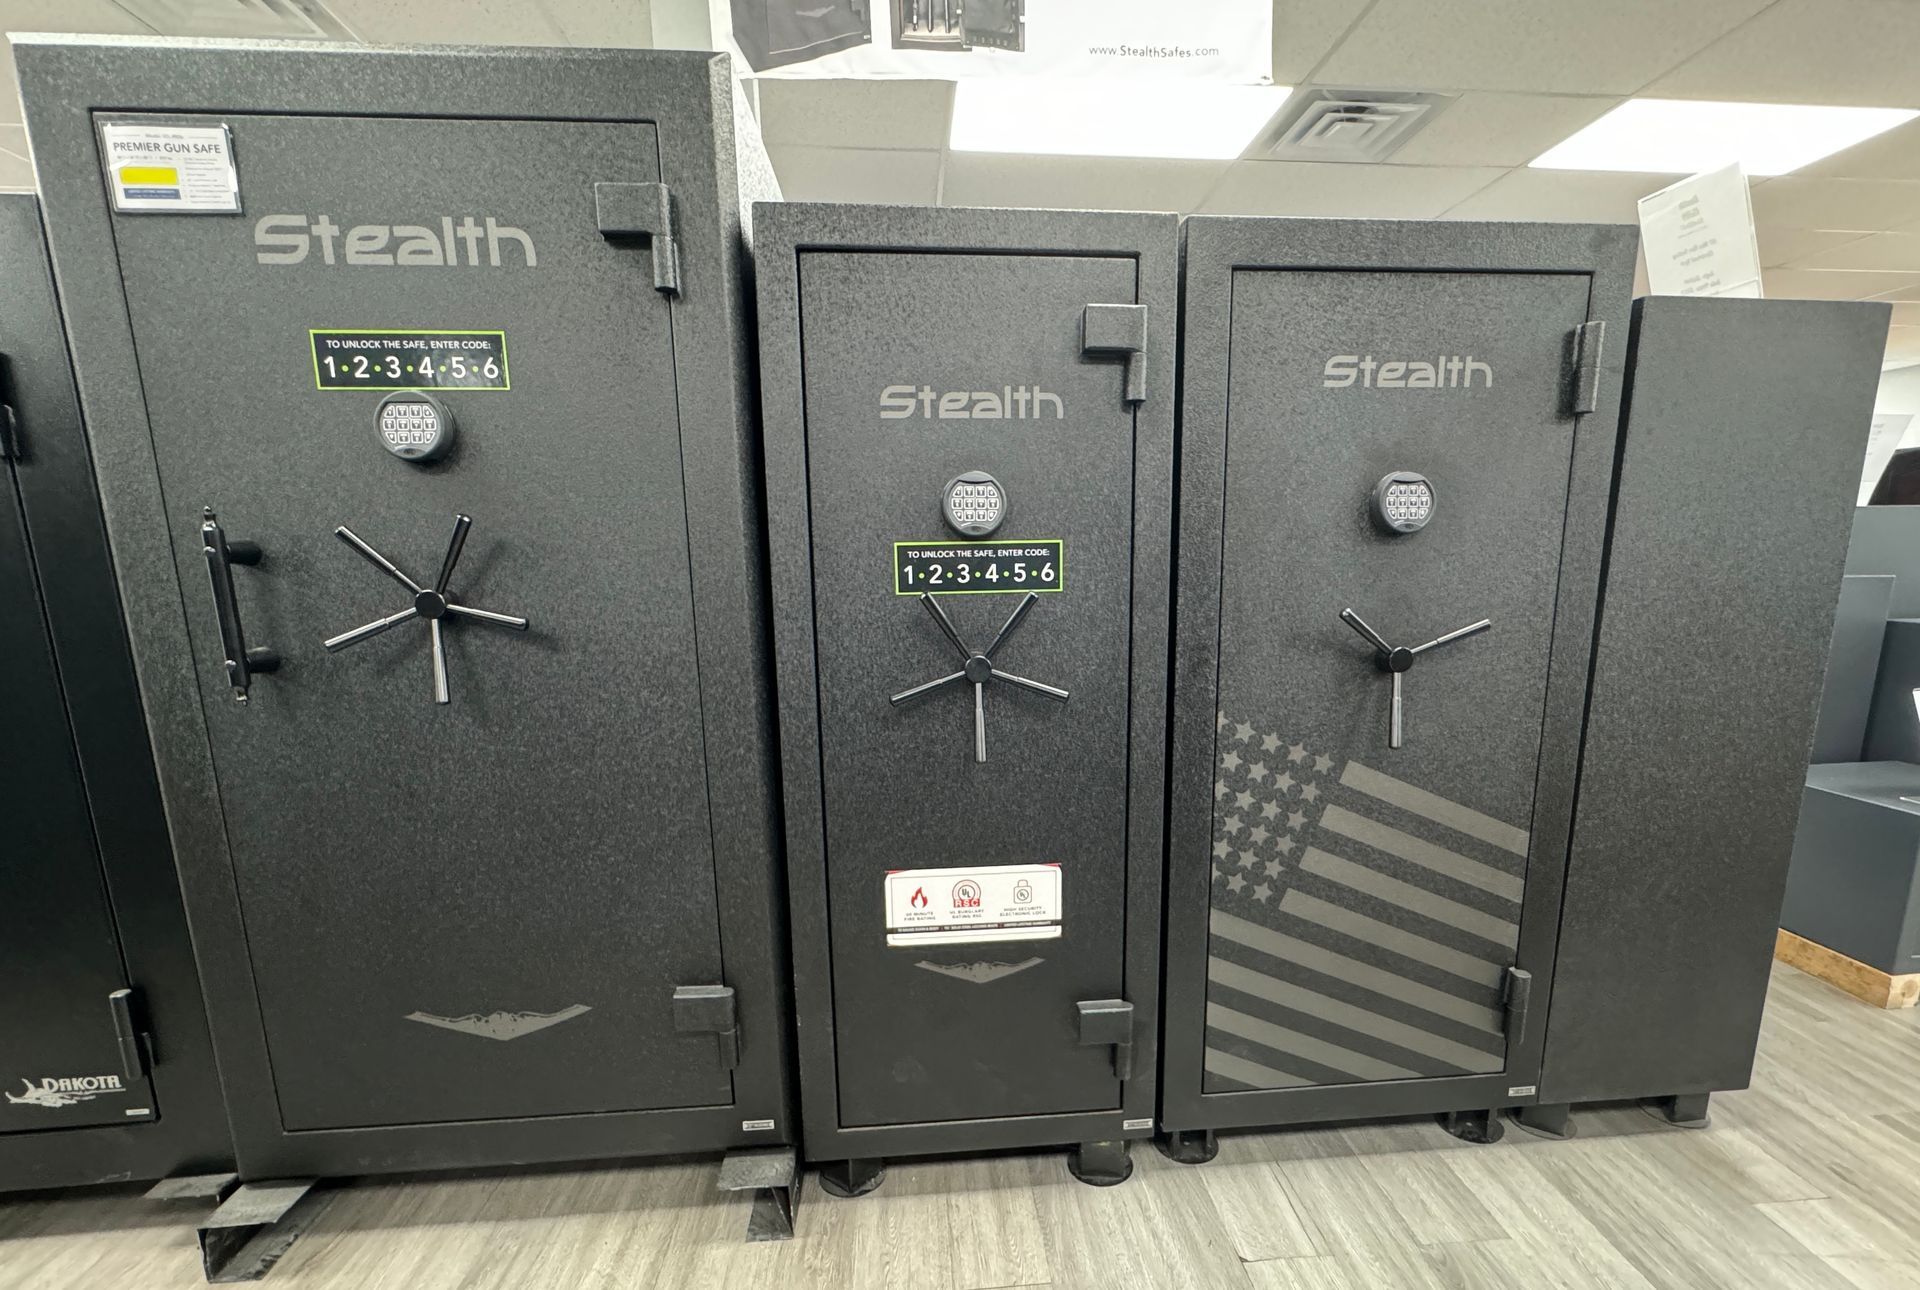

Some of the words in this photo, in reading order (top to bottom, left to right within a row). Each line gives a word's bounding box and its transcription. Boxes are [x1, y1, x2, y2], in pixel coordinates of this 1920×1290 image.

[1088, 44, 1219, 58] www.StealthSafes.com
[112, 142, 161, 152] PREMIER
[164, 143, 190, 153] GUN
[193, 143, 221, 154] SAFE
[254, 214, 537, 267] Stealth
[325, 339, 340, 349] TO
[342, 339, 381, 349] UNLOCK
[382, 340, 401, 349] THE
[402, 340, 428, 350] SAFE,
[430, 340, 460, 349] ENTER
[1323, 355, 1493, 388] Stealth
[880, 384, 1064, 419] Stealth
[907, 551, 920, 559] TO
[921, 550, 955, 559] UNLOCK
[956, 550, 972, 558] THE
[973, 550, 996, 558] SAFE,
[997, 549, 1023, 557] ENTER
[1024, 548, 1050, 556] CODE:
[954, 898, 980, 907] RSC
[41, 1074, 122, 1093] DAKOTA
